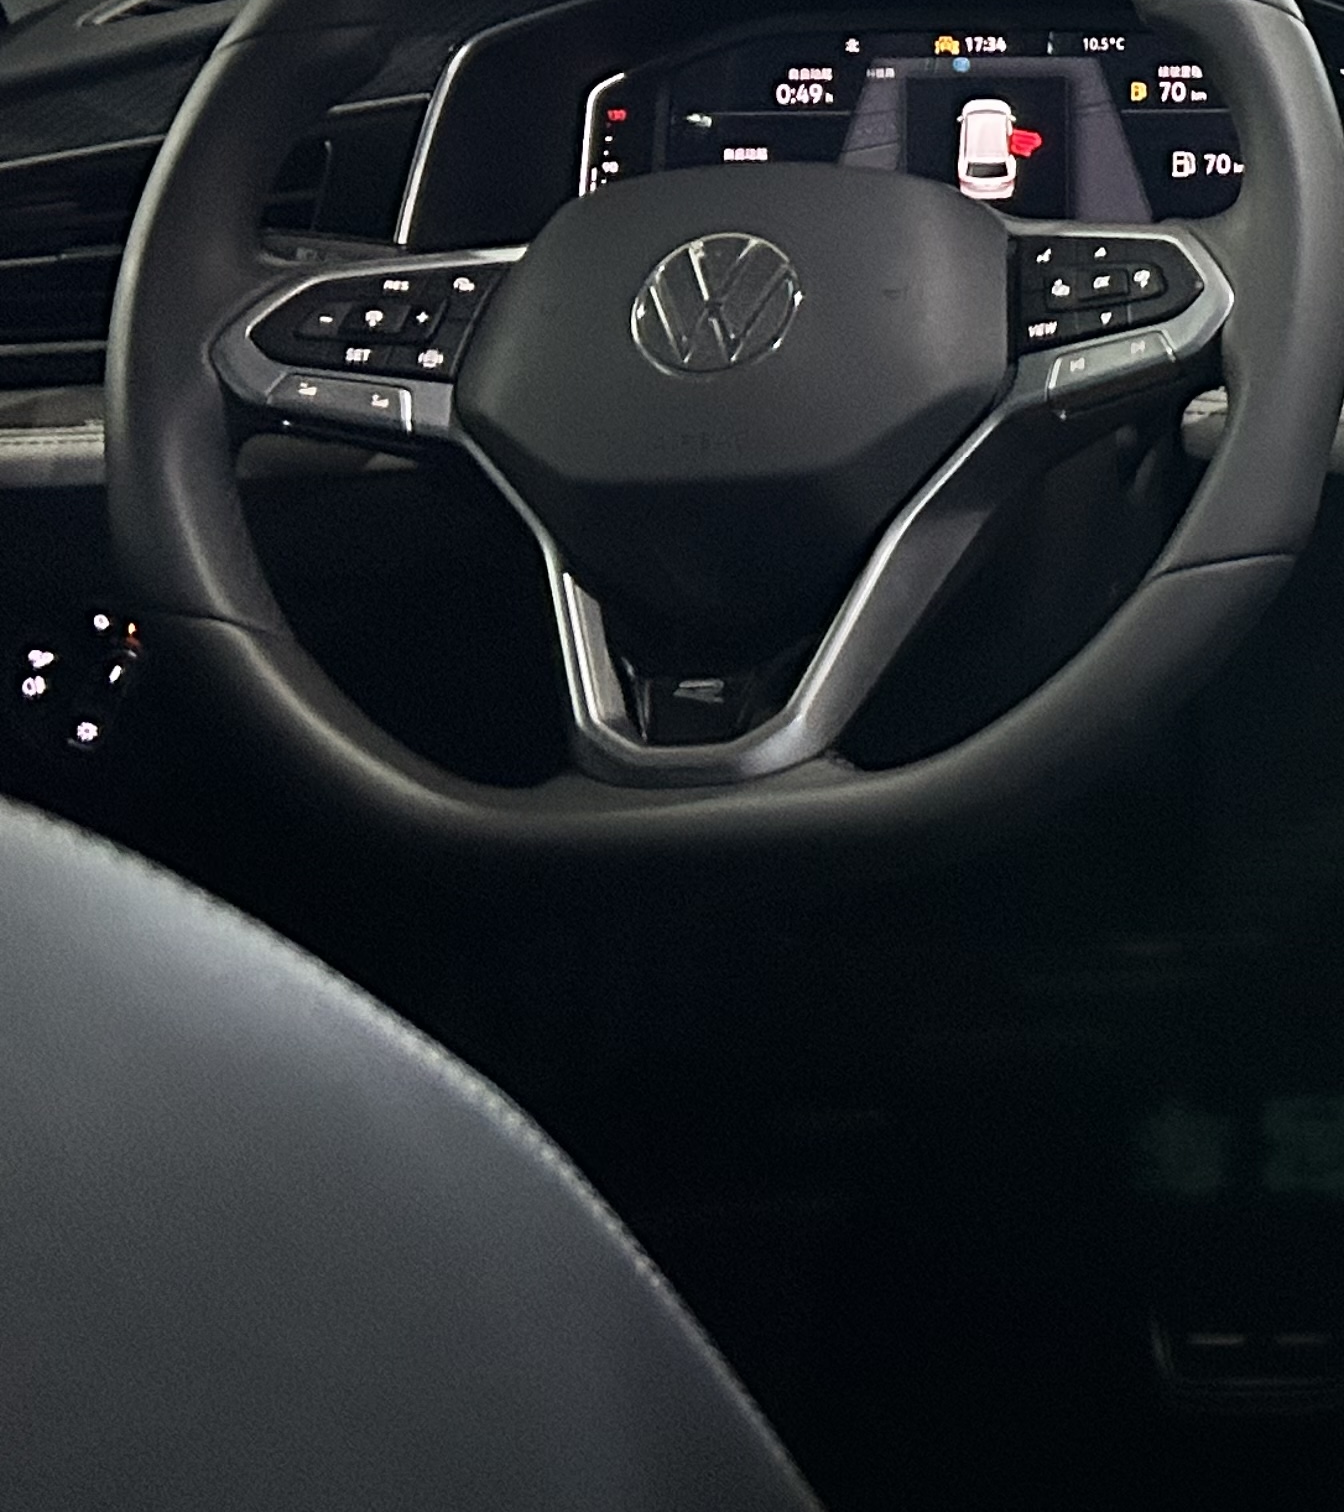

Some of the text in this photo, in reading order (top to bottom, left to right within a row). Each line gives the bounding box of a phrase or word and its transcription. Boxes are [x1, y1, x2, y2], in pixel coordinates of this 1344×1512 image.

[964, 36, 1007, 53] 17:34
[775, 83, 823, 106] 0:49
[1159, 81, 1187, 103] 70
[1203, 152, 1231, 176] 70
